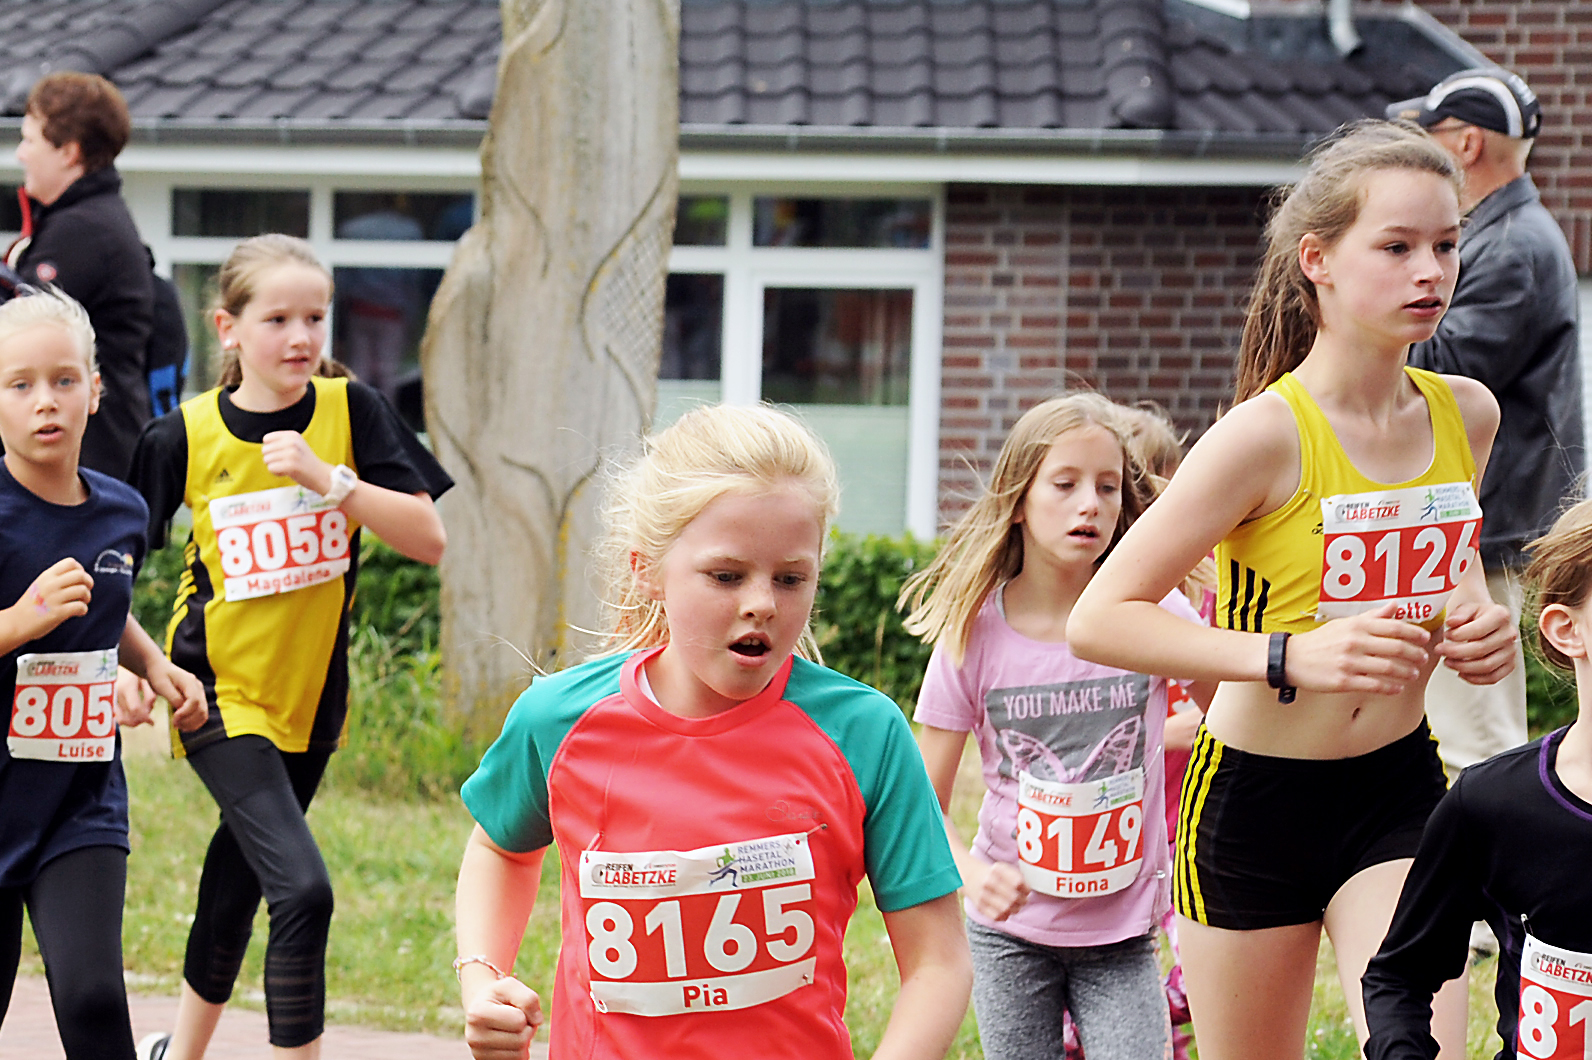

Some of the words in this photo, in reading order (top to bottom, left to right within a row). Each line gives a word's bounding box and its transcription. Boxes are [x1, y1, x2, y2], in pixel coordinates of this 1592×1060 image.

[1346, 504, 1401, 521] LABETZKE
[217, 509, 350, 578] 8058
[1323, 521, 1477, 600] 8126
[1394, 601, 1433, 620] ette
[11, 683, 116, 738] 805
[1003, 693, 1043, 721] YOU
[1049, 687, 1104, 716] MAKE
[1109, 681, 1137, 710] ME
[58, 742, 106, 759] Luise
[1016, 804, 1143, 872] 8149
[738, 851, 782, 863] HASETAL
[740, 857, 796, 873] MARATHON
[604, 869, 677, 885] LABETZKE
[1056, 876, 1109, 893] Fiona
[585, 882, 815, 979] 8165
[1541, 953, 1567, 967] REIFEN
[683, 983, 729, 1009] Pia
